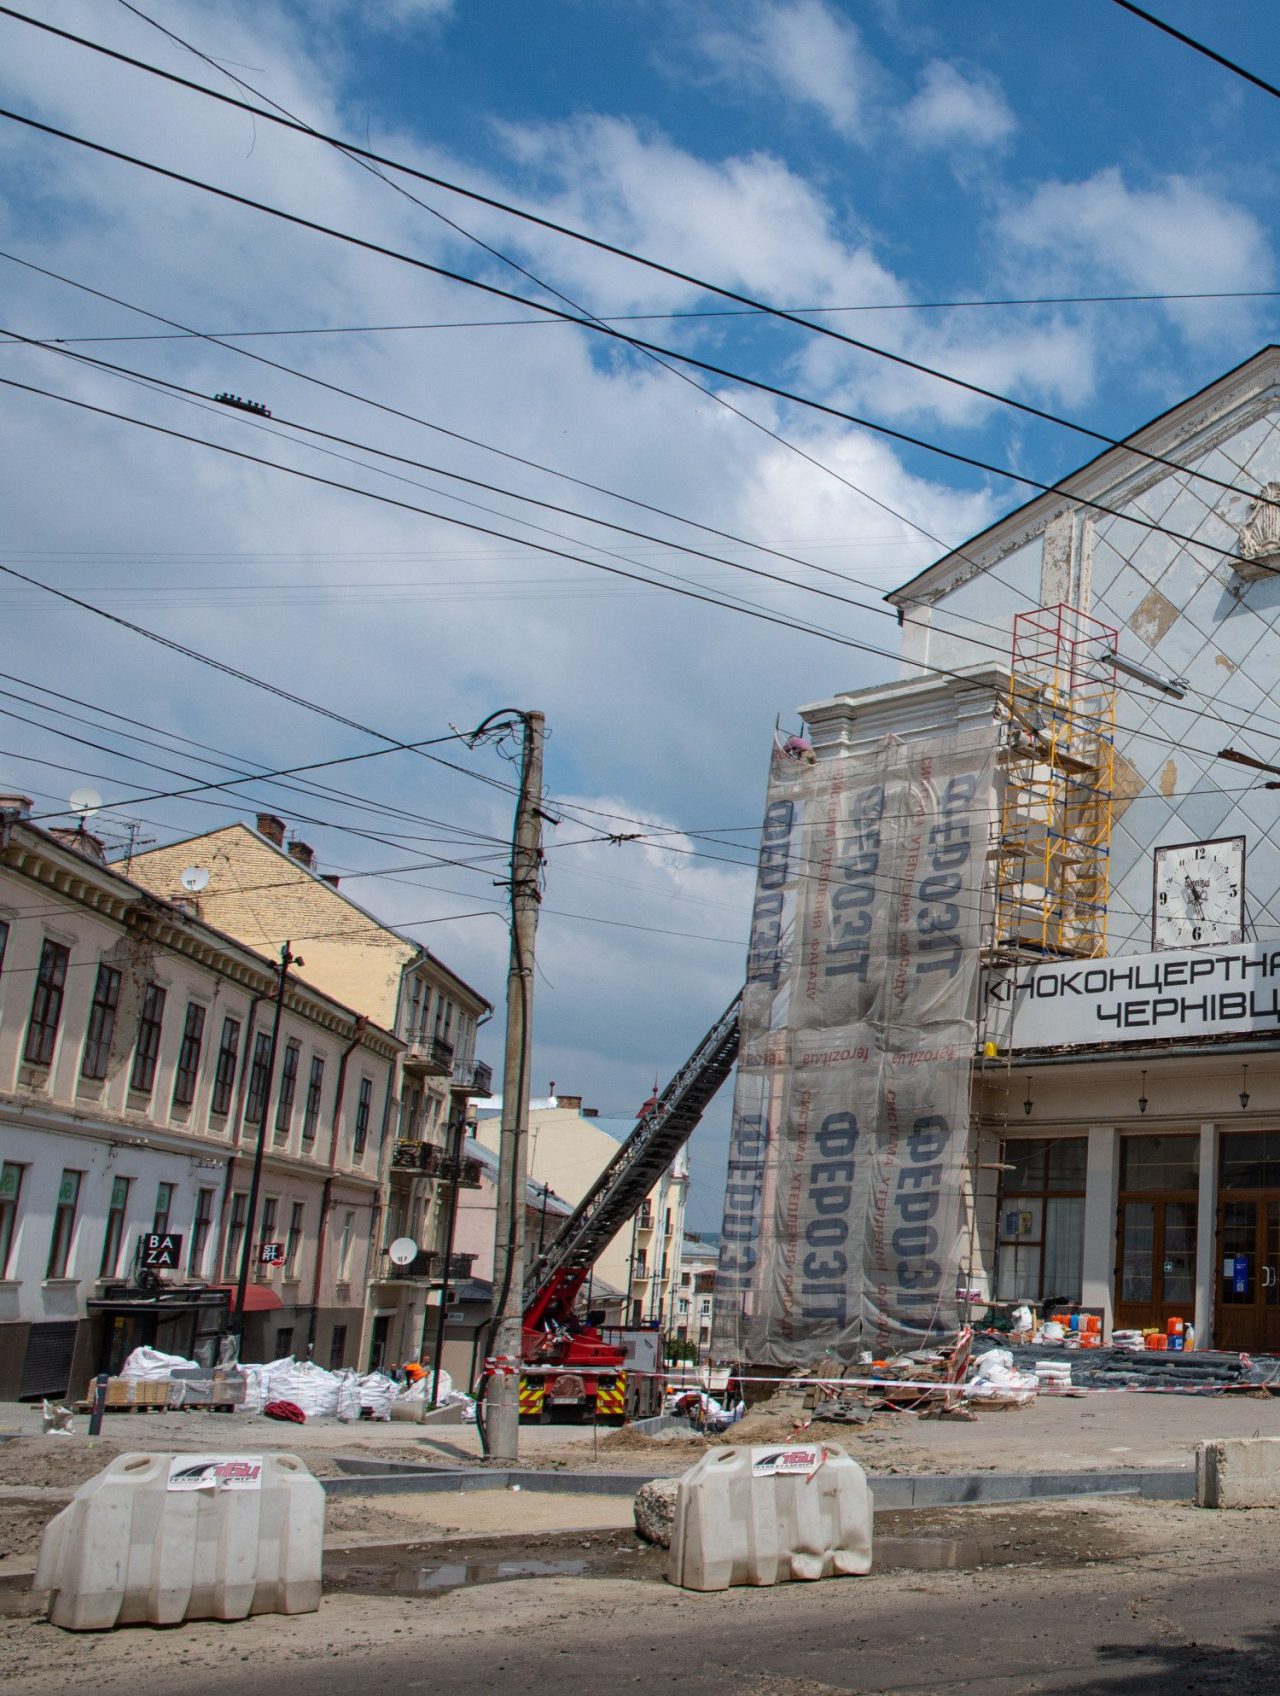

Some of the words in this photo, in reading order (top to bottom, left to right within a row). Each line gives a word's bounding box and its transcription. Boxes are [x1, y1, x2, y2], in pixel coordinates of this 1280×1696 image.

[825, 785, 885, 983] ФЕРОЗІТ
[900, 836, 922, 924] УТЕПЛЕННЯ
[915, 773, 978, 980] ФЕРОЗІТ
[1194, 847, 1206, 860] 12
[1224, 866, 1229, 874] 2
[812, 846, 835, 930] УТЕПЛЕННЯ
[1160, 891, 1167, 905] 9
[1229, 884, 1238, 897] 3
[1178, 928, 1182, 936] 7
[1192, 926, 1202, 941] 6
[806, 938, 821, 1000] ФАСАДУ
[892, 932, 910, 999] ФАСАДУ
[801, 1046, 870, 1067] ferozit.ua
[794, 1091, 812, 1163] СИСТЕМА
[885, 1089, 899, 1167] СИСТЕМА
[149, 1235, 173, 1249] BA
[263, 1244, 278, 1253] ST
[786, 1170, 802, 1265] УТЕПЛЕННЯ
[801, 1111, 859, 1328] ФЕРОЗІТ
[892, 1114, 951, 1337] ФЕРОЗІТ
[147, 1250, 171, 1264] ZA
